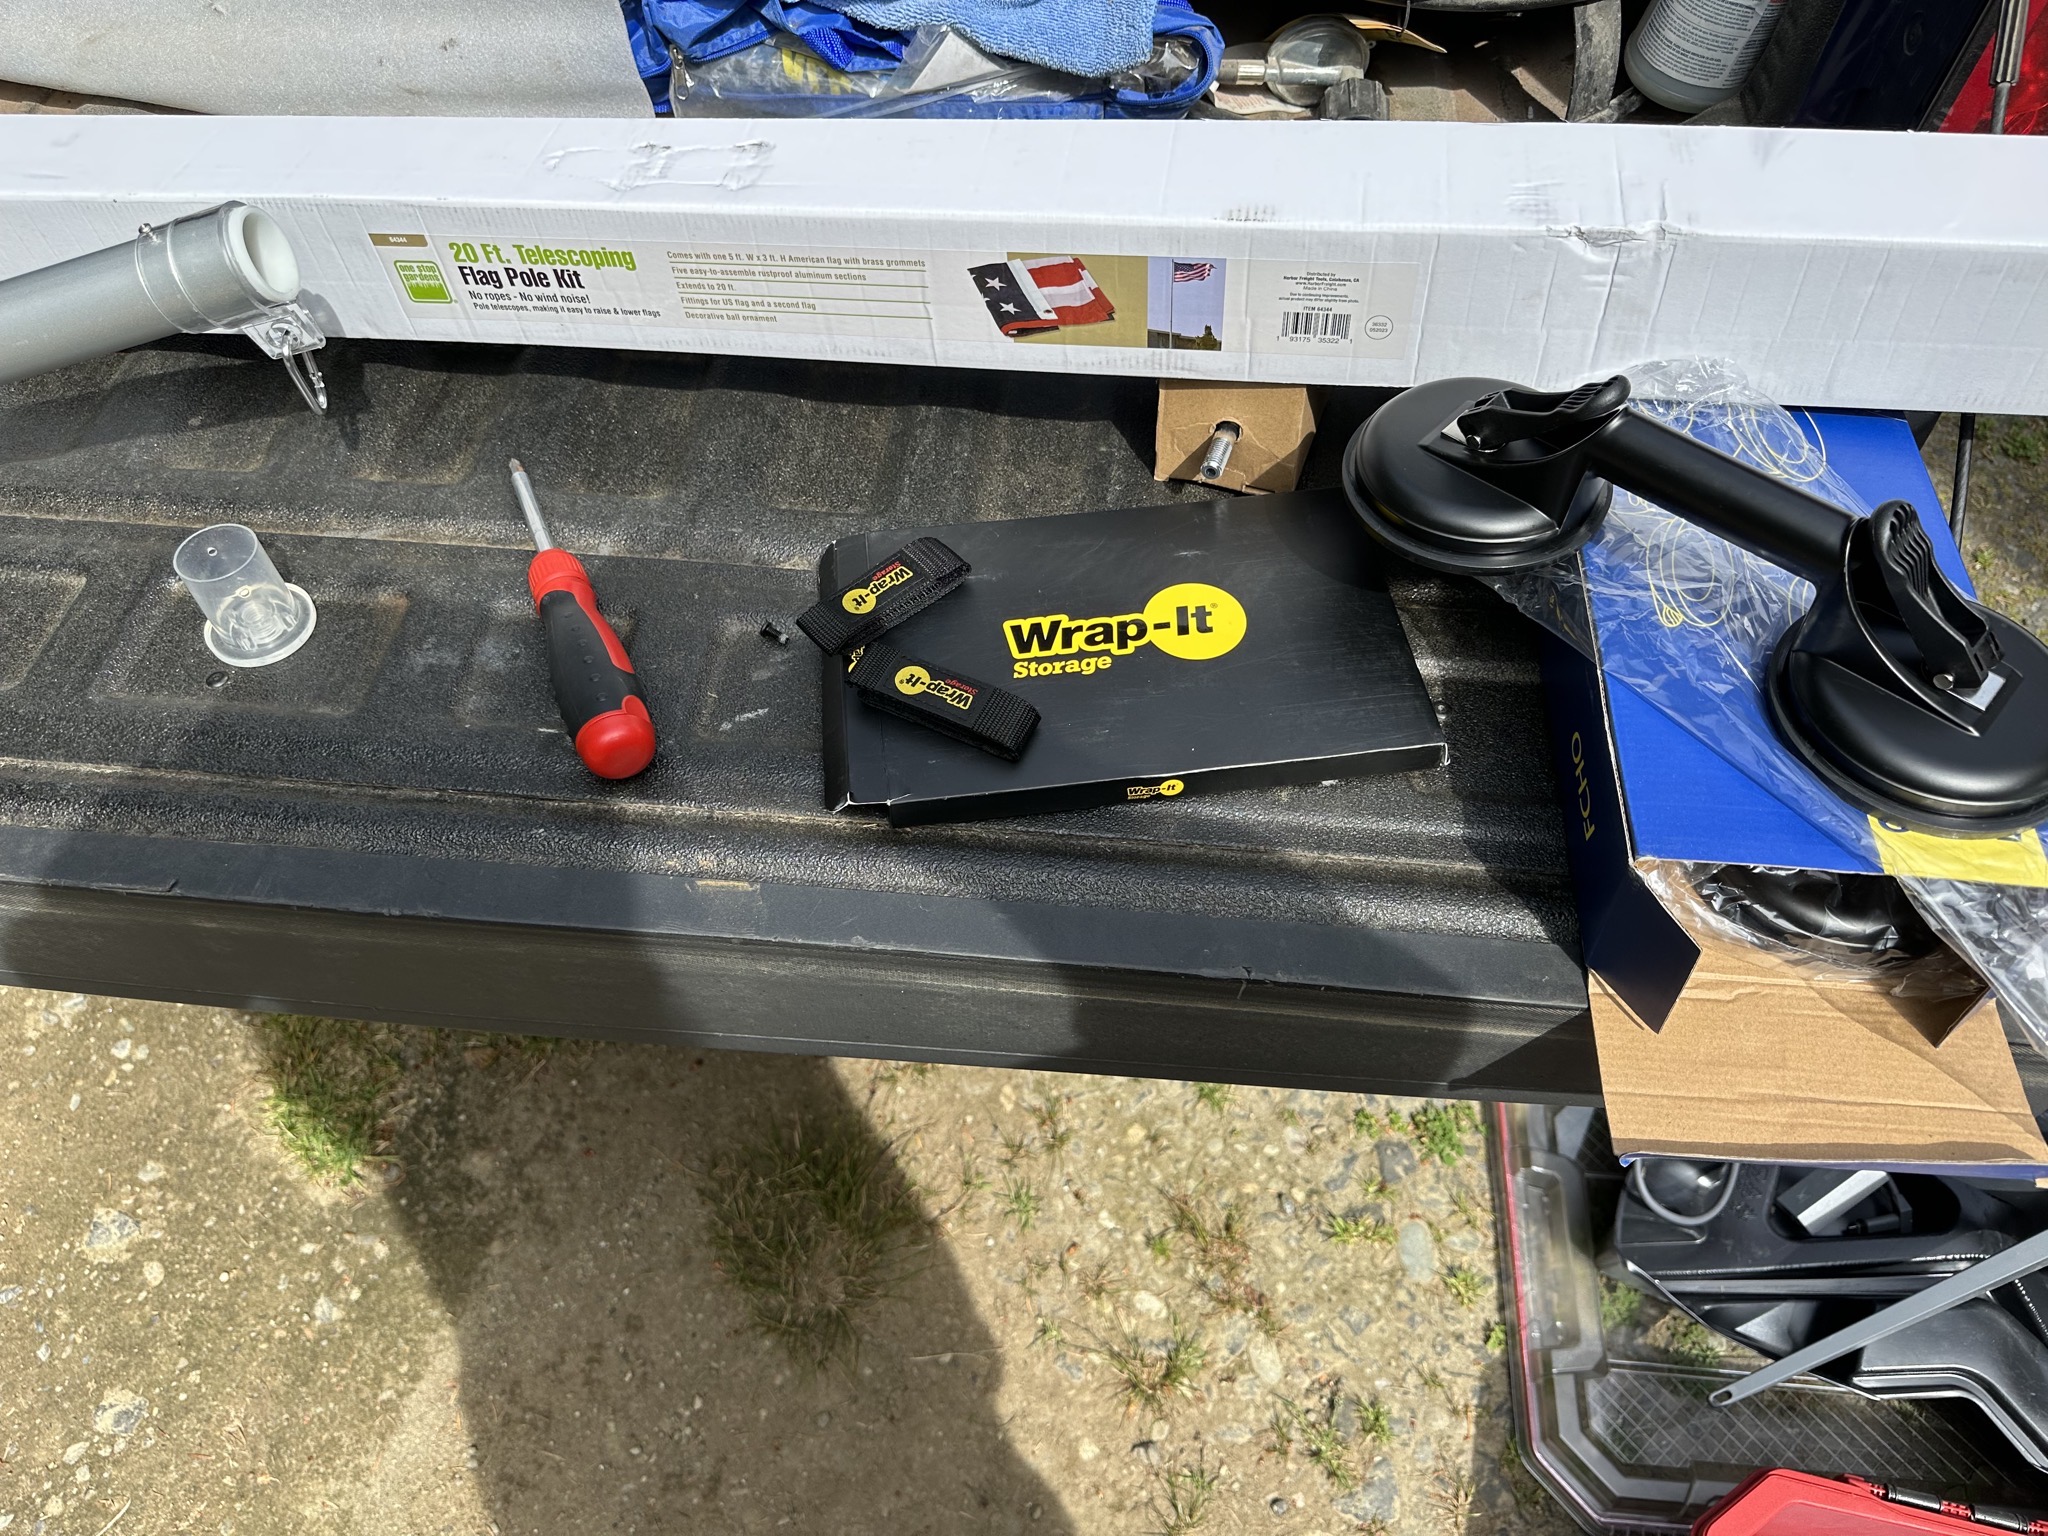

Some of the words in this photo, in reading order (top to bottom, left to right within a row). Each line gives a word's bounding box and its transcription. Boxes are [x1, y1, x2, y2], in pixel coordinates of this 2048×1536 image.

[449, 242, 478, 263] 20
[484, 243, 511, 265] Ft.
[512, 244, 637, 271] Telescoping
[667, 250, 693, 260] Comes
[694, 251, 711, 261] with
[713, 253, 727, 261] one
[728, 252, 734, 261] 5
[735, 252, 744, 262] ft.
[746, 253, 755, 262] W
[762, 253, 768, 262] 3
[769, 253, 778, 263] ft.
[780, 254, 786, 263] H
[788, 254, 825, 264] American
[826, 255, 842, 267] flag
[843, 256, 860, 265] with
[862, 257, 884, 266] brass
[886, 258, 926, 269] grommets
[398, 264, 415, 273] one
[416, 264, 437, 274] stop
[403, 273, 440, 282] gardens
[458, 265, 501, 289] Flag
[504, 267, 551, 288] Pole
[556, 269, 586, 289] Kit
[671, 266, 688, 275] Five
[689, 267, 757, 277] easy-to-assemble
[757, 269, 793, 280] rustproof
[794, 270, 832, 280] aluminum
[834, 272, 867, 281] sections
[676, 281, 706, 290] Extends
[707, 282, 715, 291] to
[716, 282, 727, 291] 20
[727, 282, 736, 291] ft.
[469, 290, 483, 300] No
[484, 292, 512, 303] ropes
[519, 292, 534, 302] No
[535, 292, 558, 303] wind
[560, 294, 590, 304] noise!
[681, 296, 709, 306] Fittings
[709, 297, 721, 305] for
[722, 297, 733, 306] US
[734, 298, 750, 308] flag
[751, 298, 765, 307] and
[773, 300, 800, 309] second
[801, 301, 816, 311] flag
[473, 302, 490, 311] Pole
[490, 303, 531, 313] telescopes,
[532, 305, 559, 314] making
[567, 307, 583, 316] easy
[584, 307, 592, 315] to
[593, 307, 611, 315] raise
[613, 307, 620, 315] &
[621, 308, 641, 316] lower
[642, 309, 661, 318] flags
[685, 311, 725, 320] Decorative
[726, 312, 741, 321] ball
[743, 314, 777, 323] ornament
[872, 561, 901, 581] Storage
[852, 566, 912, 608] Wrap-It
[1007, 602, 1217, 656] Wrap-It
[1012, 655, 1113, 680] Storage
[904, 673, 972, 709] Wrap-It
[945, 678, 978, 696] Storage
[1128, 784, 1177, 795] Wrap-It
